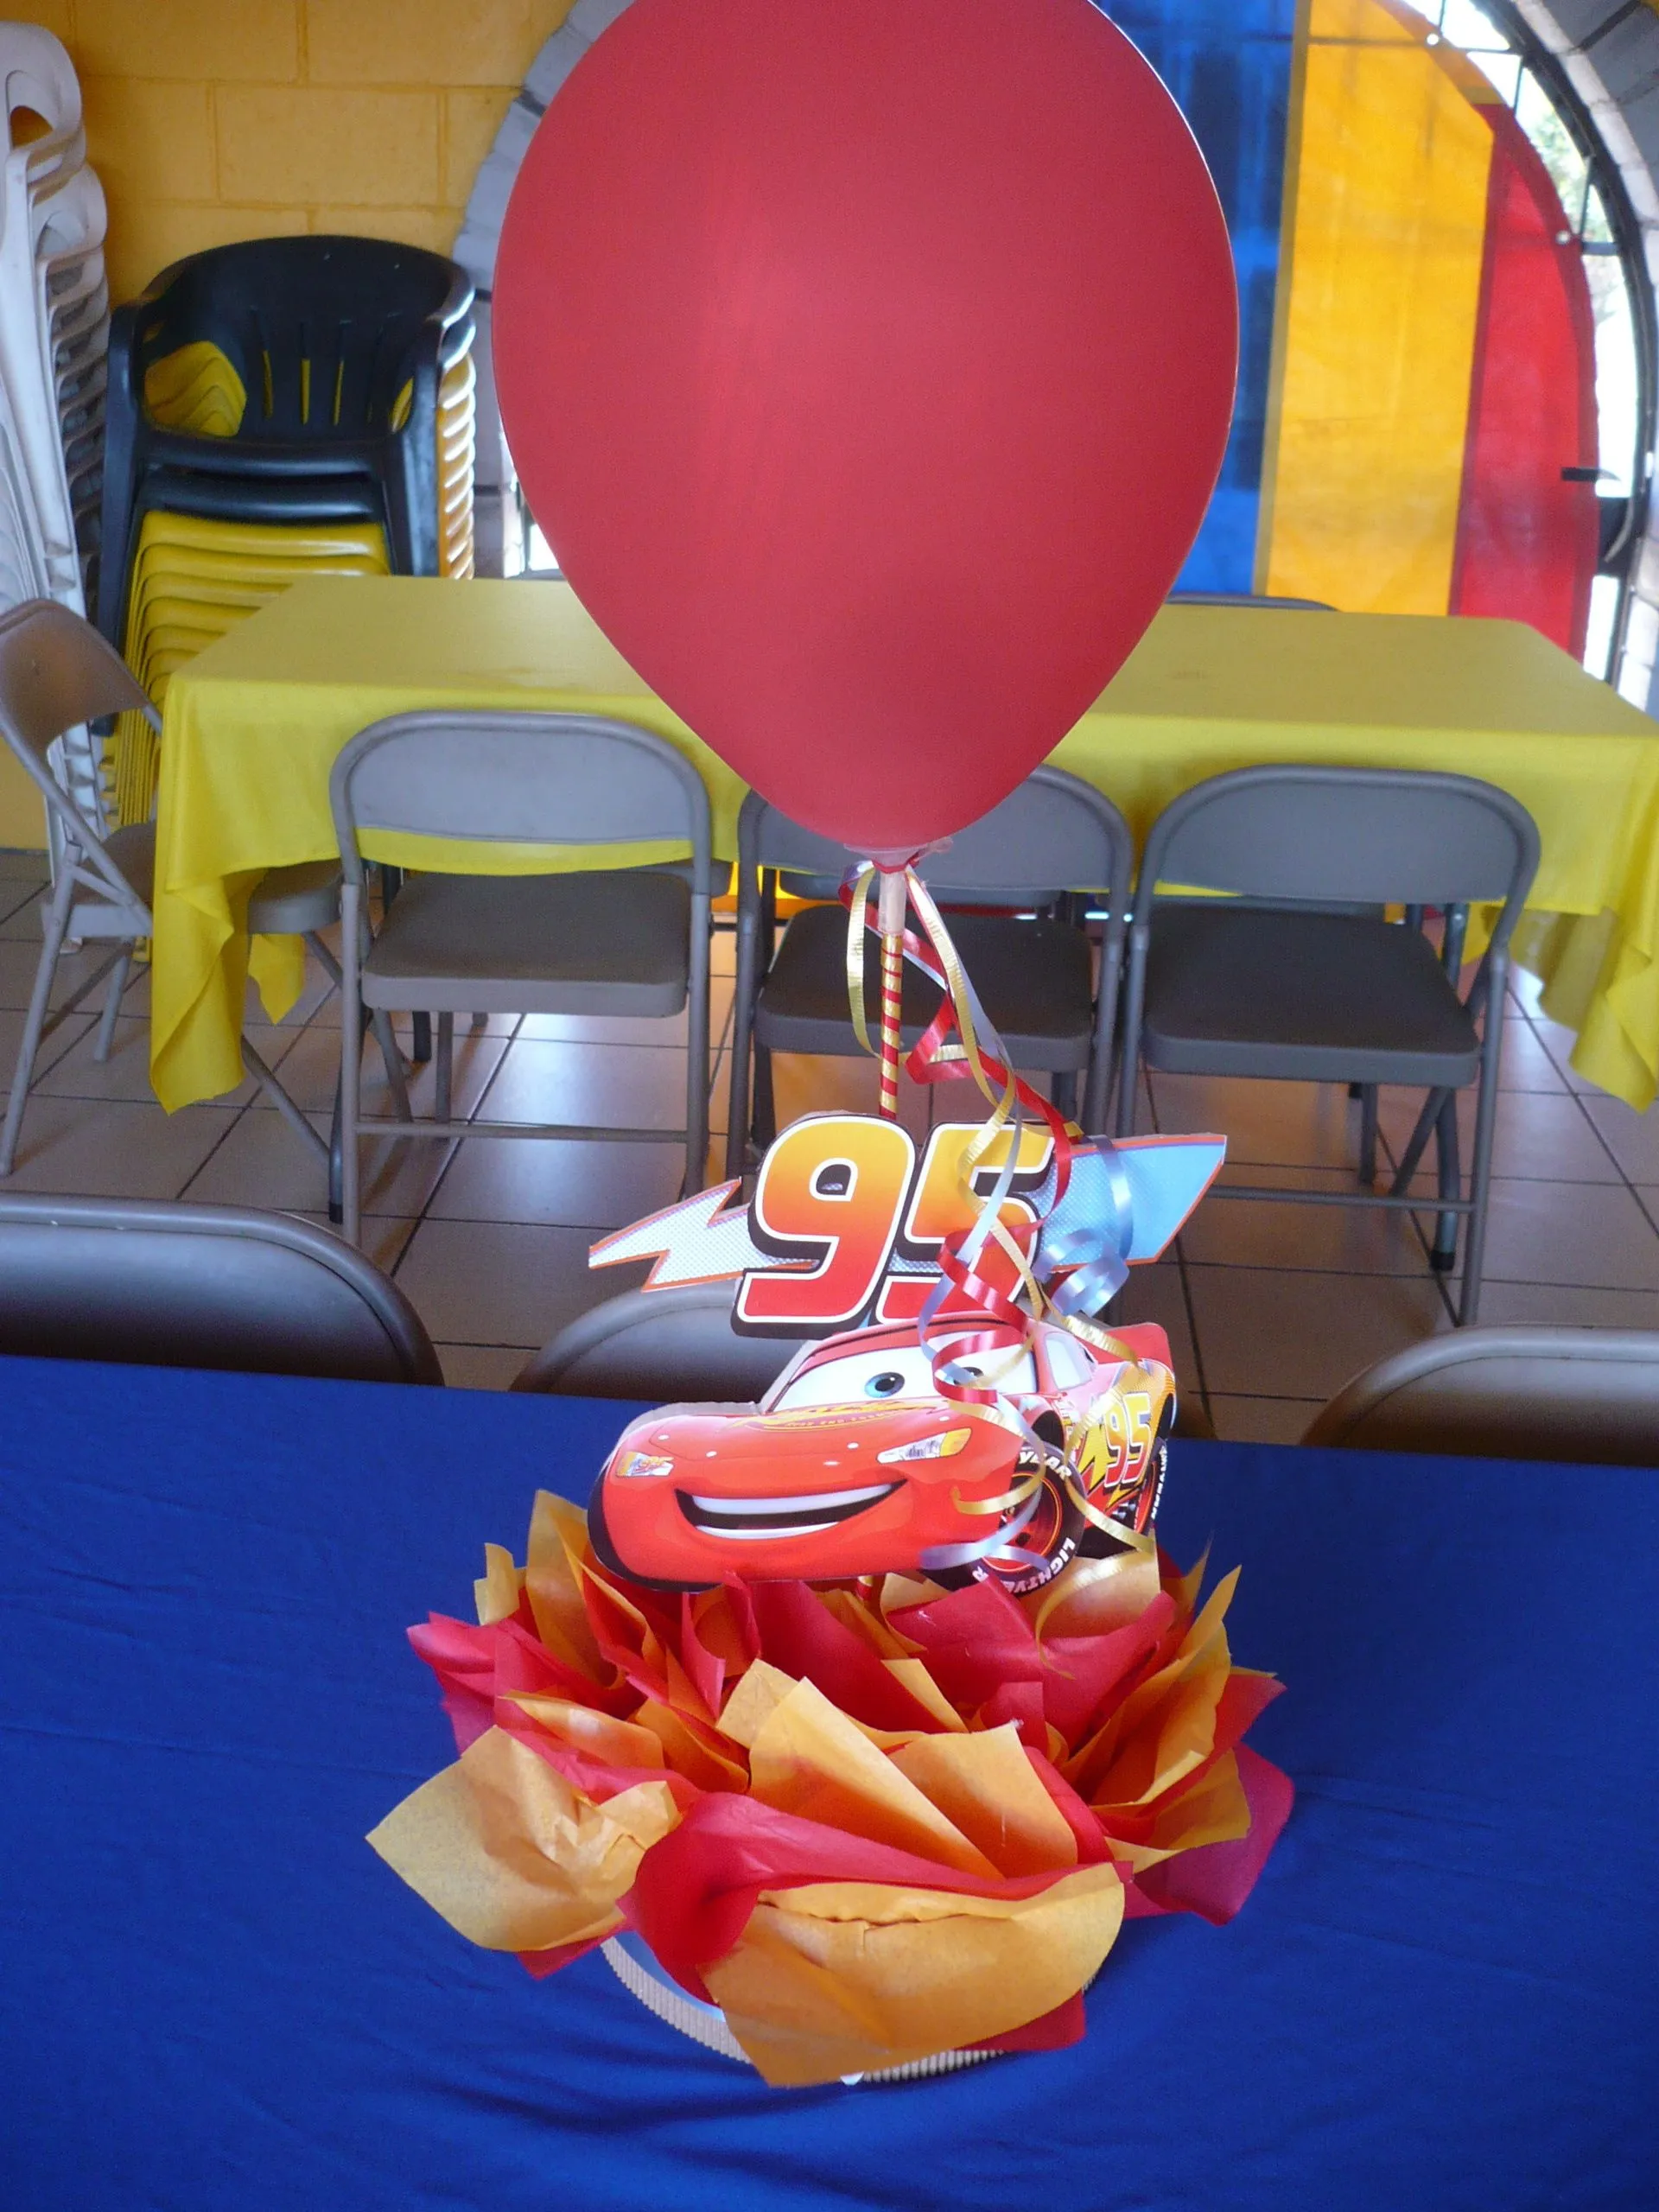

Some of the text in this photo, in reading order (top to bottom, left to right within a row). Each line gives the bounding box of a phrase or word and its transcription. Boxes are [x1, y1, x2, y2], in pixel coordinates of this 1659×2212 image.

[737, 1115, 1054, 1324] 95
[1104, 1392, 1151, 1488] 95
[972, 1537, 1076, 1592] LIGHTYER
